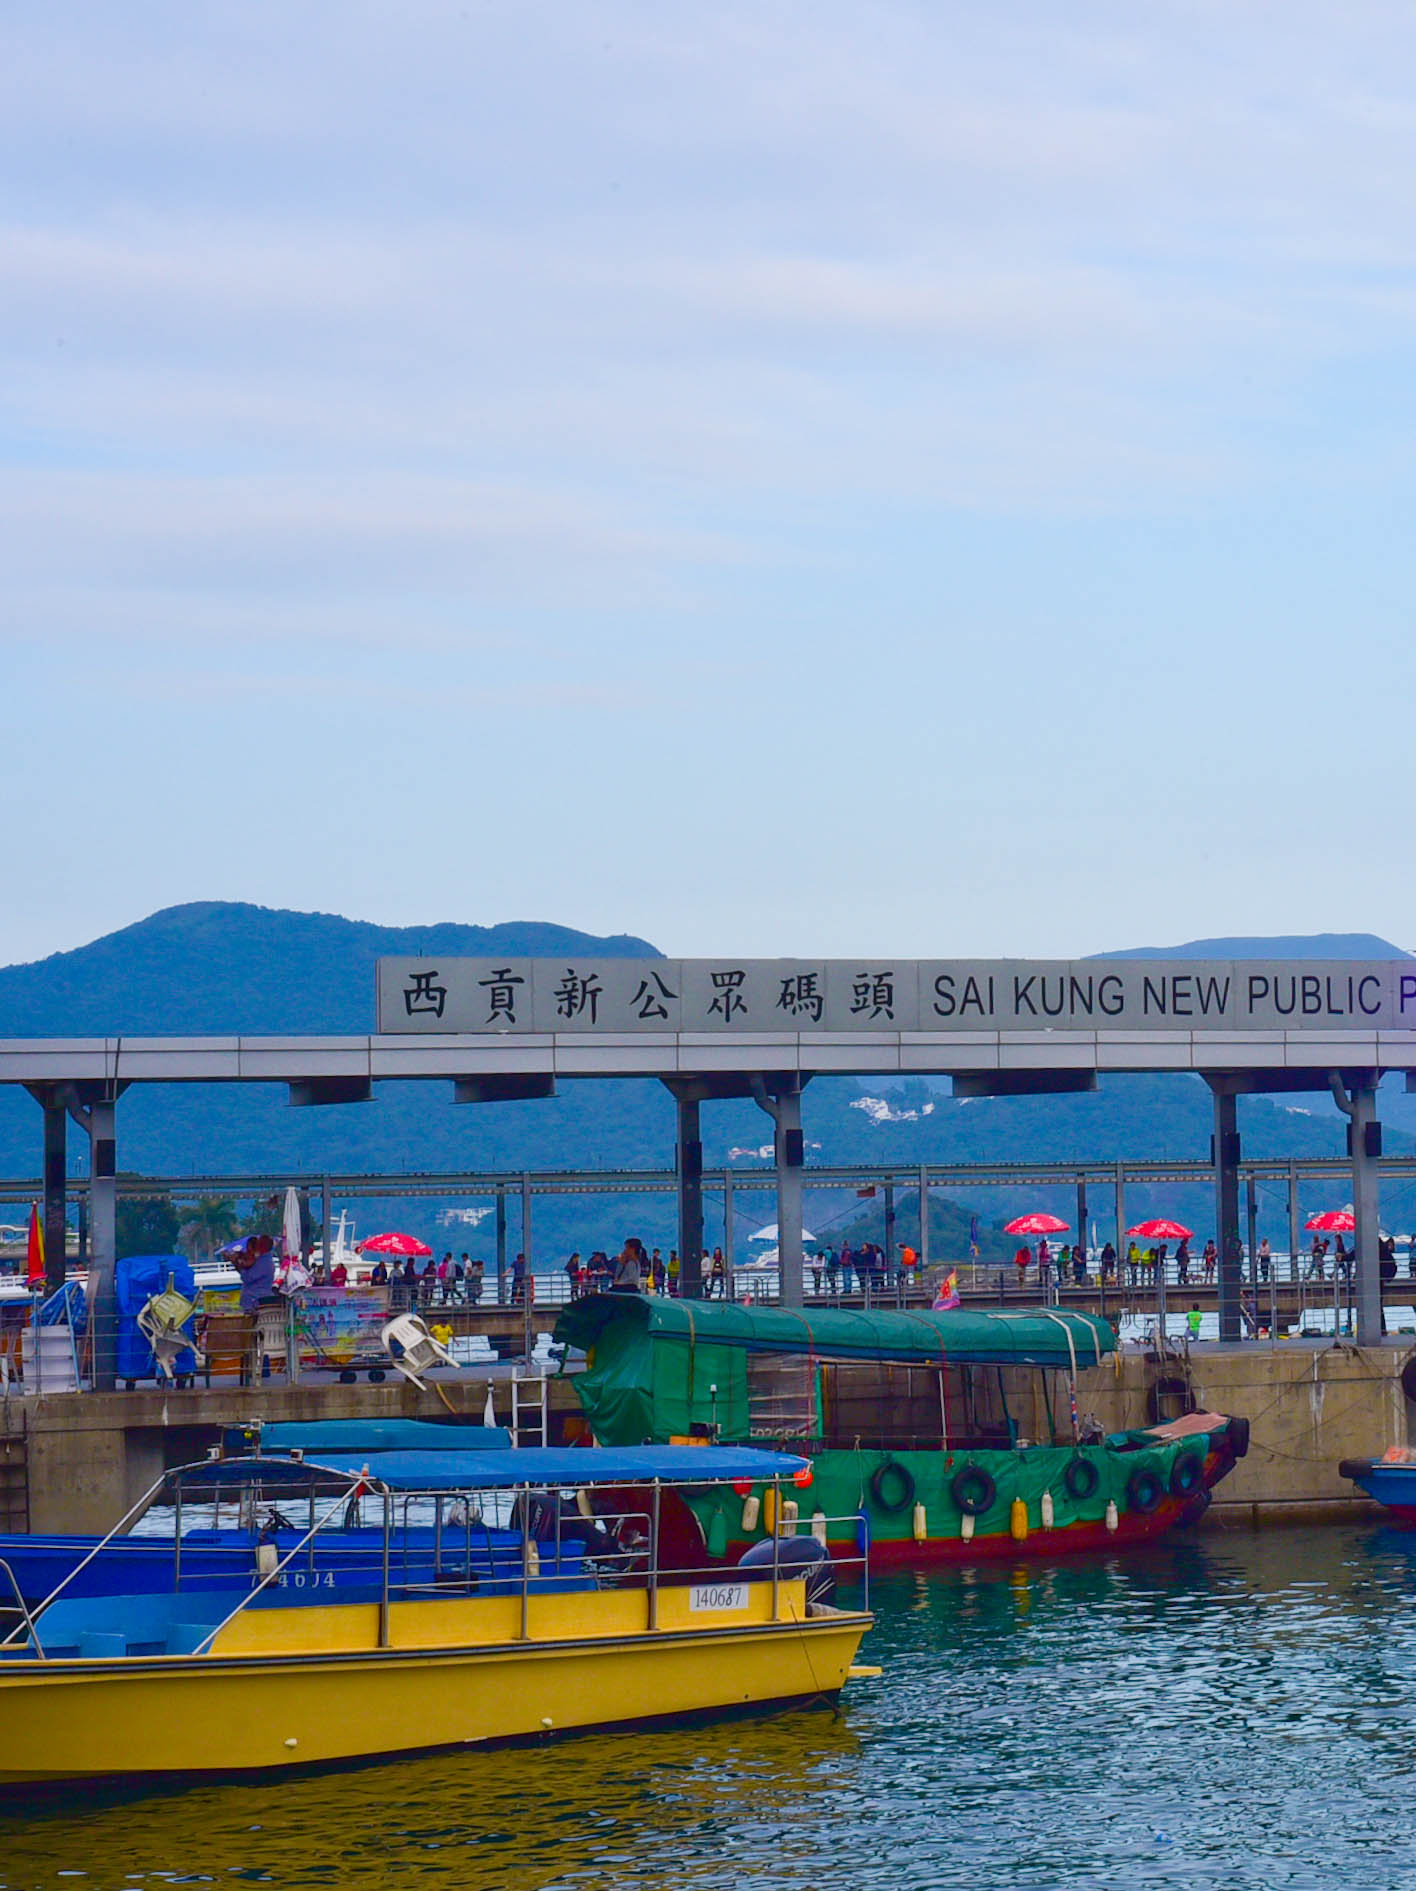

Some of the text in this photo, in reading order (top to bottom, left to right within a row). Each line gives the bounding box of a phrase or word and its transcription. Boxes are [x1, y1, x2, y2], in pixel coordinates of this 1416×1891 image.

[403, 968, 895, 1024] 西貢新公眾碼頭
[933, 975, 994, 1016] SAI
[1014, 975, 1124, 1016] KUNG
[1144, 976, 1230, 1015] NEW
[1248, 975, 1381, 1015] PUBLIC
[695, 1587, 742, 1608] 140687
